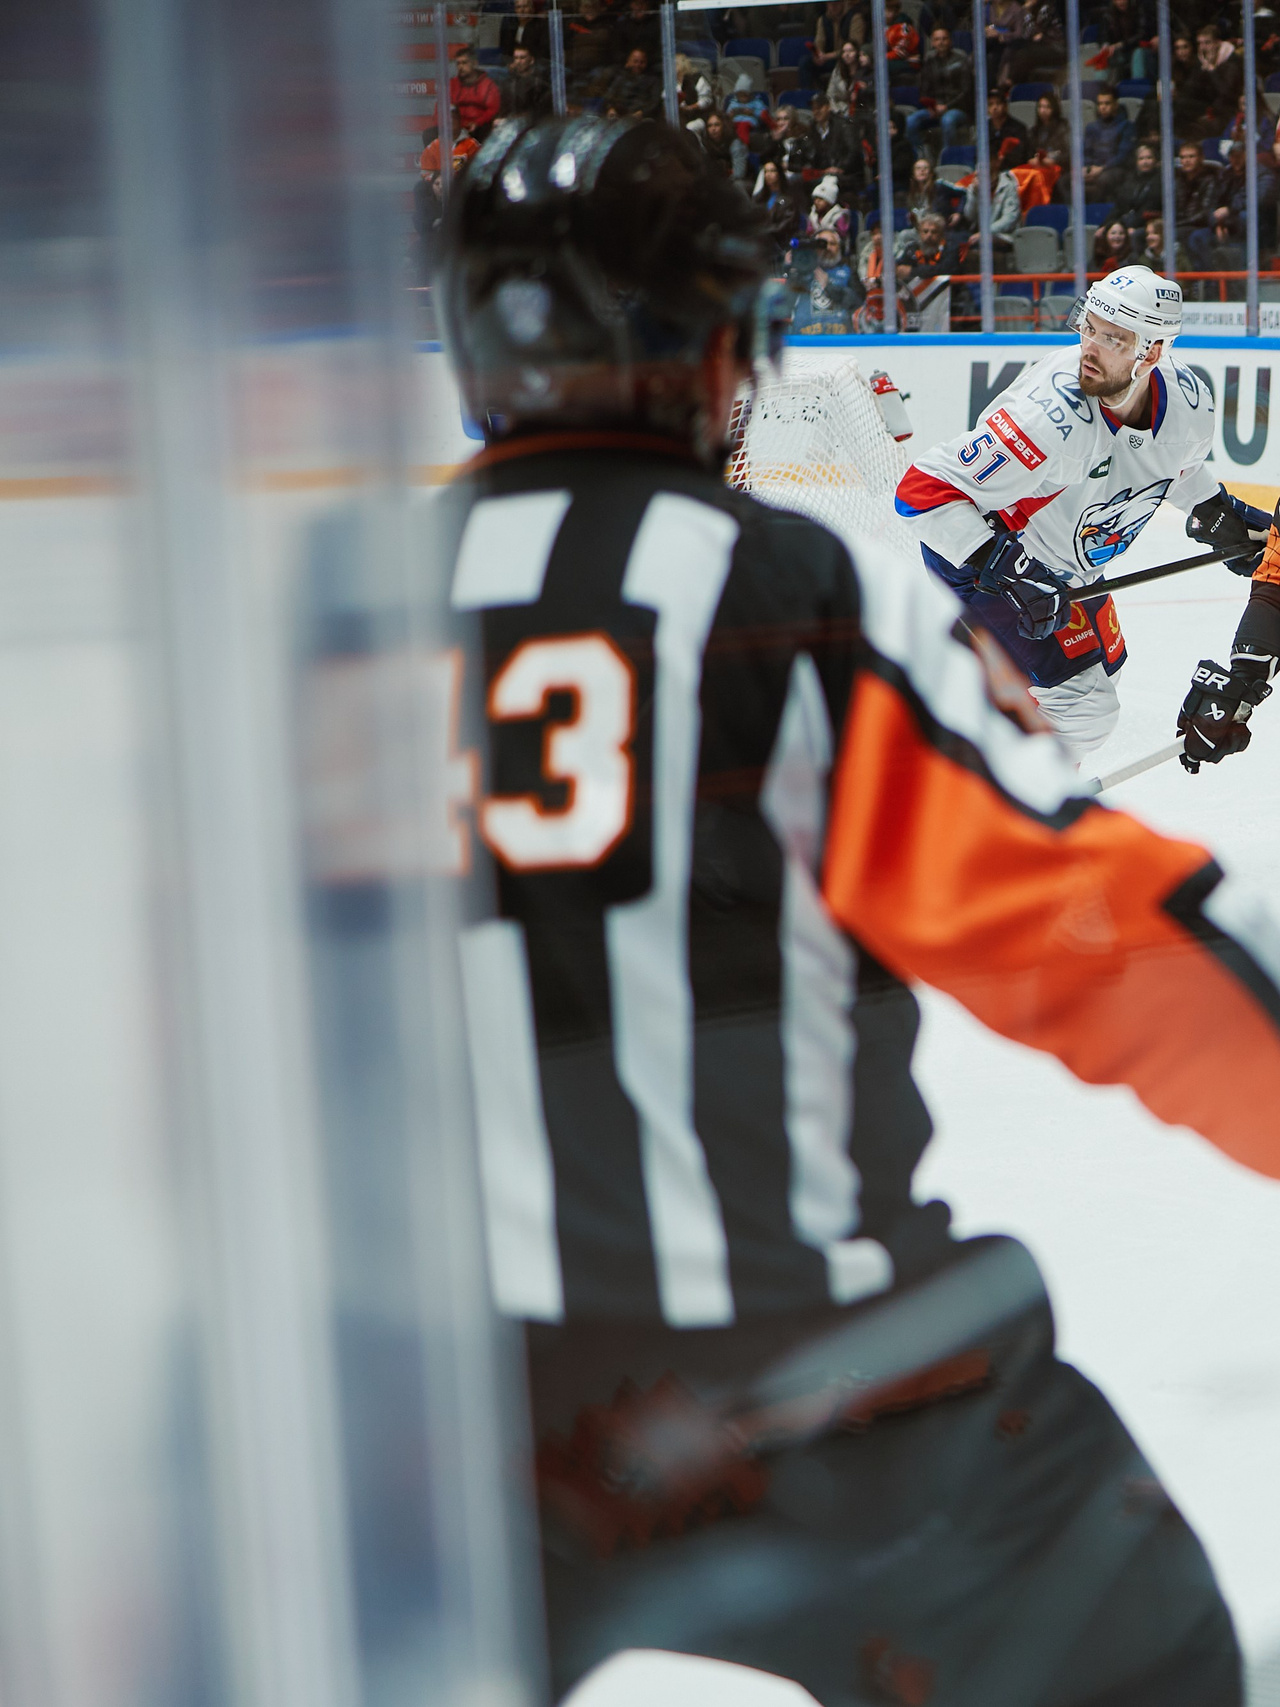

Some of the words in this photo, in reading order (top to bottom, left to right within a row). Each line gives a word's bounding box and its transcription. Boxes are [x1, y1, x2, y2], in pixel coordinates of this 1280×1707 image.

[1110, 275, 1134, 290] 51
[1158, 289, 1180, 301] LADA
[1028, 386, 1073, 442] LADA
[957, 430, 1011, 486] 51
[991, 412, 1041, 467] OLIMPBET
[1210, 512, 1226, 534] CCM
